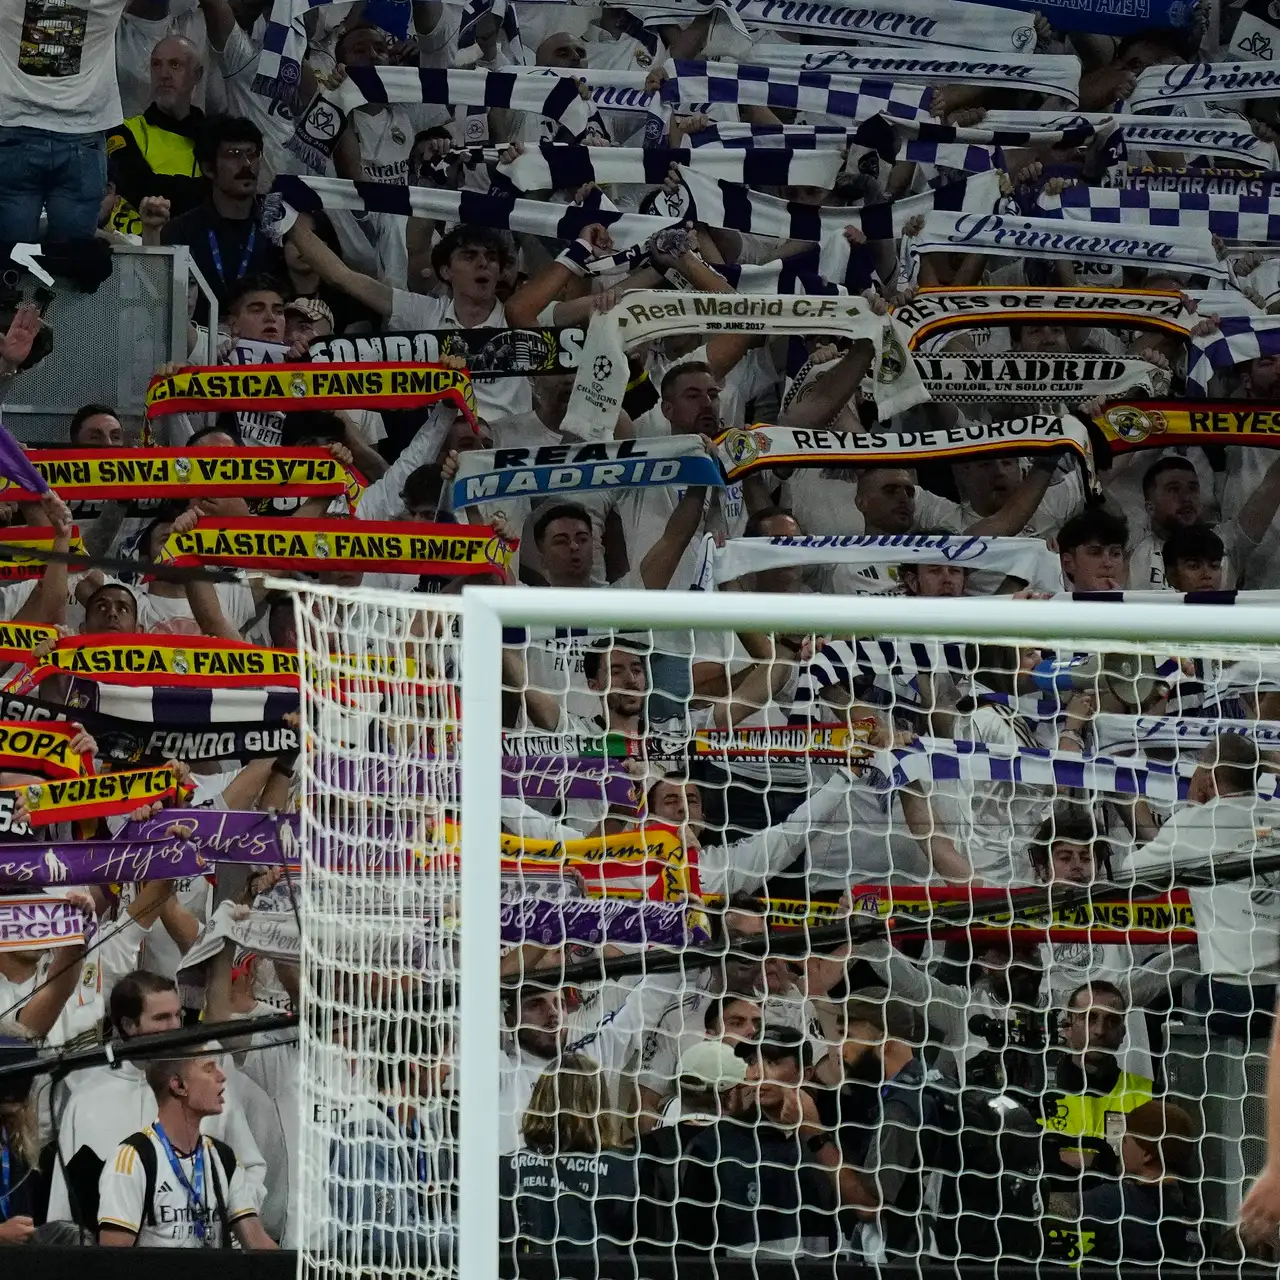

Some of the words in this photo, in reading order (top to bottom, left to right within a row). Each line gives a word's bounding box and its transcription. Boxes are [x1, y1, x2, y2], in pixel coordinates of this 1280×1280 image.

[949, 211, 1175, 260] Primavera
[627, 297, 686, 325] Real
[693, 297, 783, 317] Madrid
[791, 299, 838, 318] C.F.
[896, 292, 993, 330] REYES
[999, 293, 1035, 311] DE
[1042, 293, 1186, 319] EUROPA
[966, 352, 1128, 382] MADRID
[311, 369, 381, 396] FANS
[995, 382, 1013, 393] UN
[1015, 382, 1047, 393] SOLO
[1049, 381, 1085, 393] CLUB
[793, 428, 887, 452] REYES
[895, 425, 938, 448] DE
[946, 415, 1066, 446] EUROPA
[493, 438, 649, 470] REAL
[464, 457, 683, 502] MADRID
[334, 535, 405, 560] FANS
[409, 538, 485, 562] RMCF
[193, 650, 265, 675] FANS
[143, 729, 236, 760] FONDO
